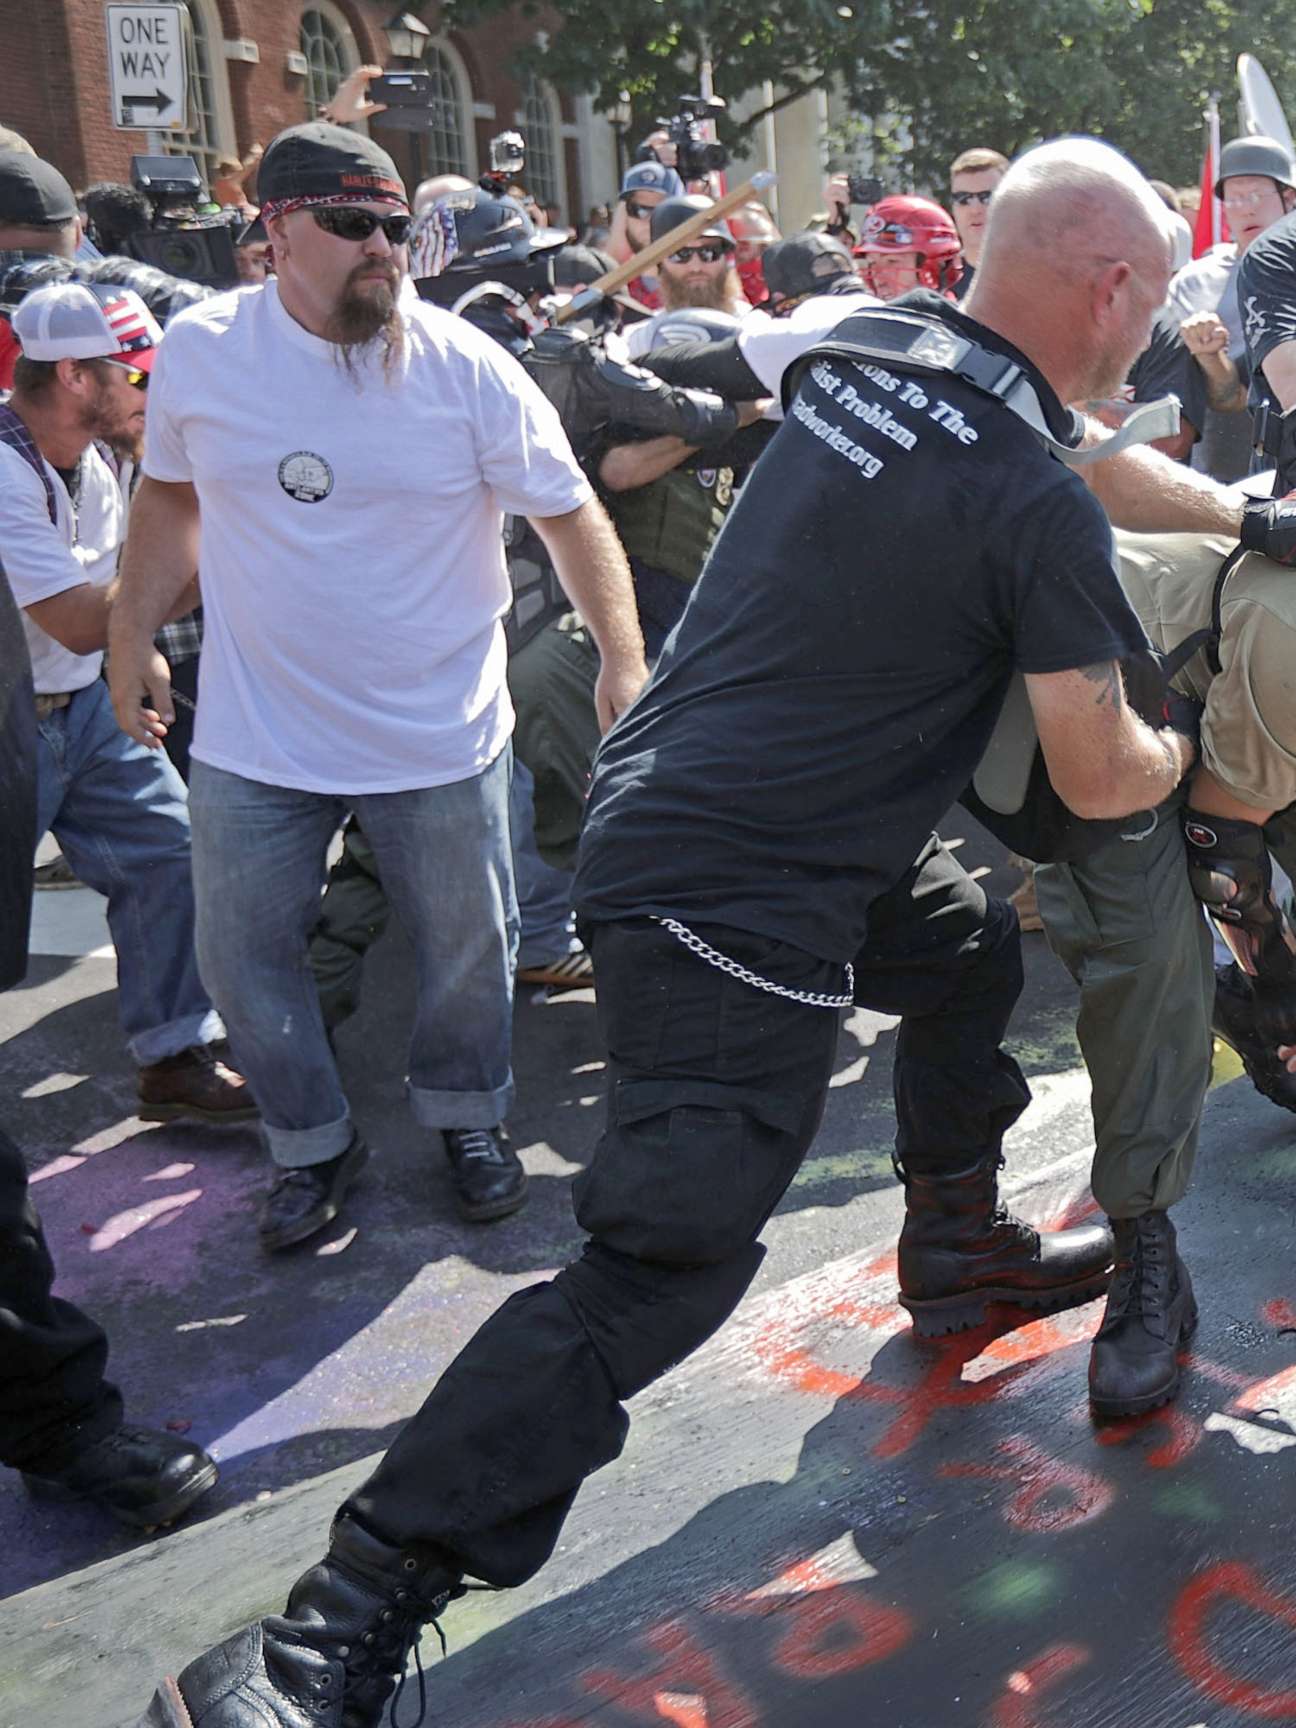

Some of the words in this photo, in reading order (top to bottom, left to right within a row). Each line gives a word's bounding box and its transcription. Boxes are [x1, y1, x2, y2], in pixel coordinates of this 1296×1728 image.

[120, 17, 169, 45] ONE
[120, 52, 170, 79] WAY
[792, 397, 885, 480] adworker.org
[834, 384, 919, 452] Problem
[897, 381, 929, 410] To
[928, 400, 979, 446] The
